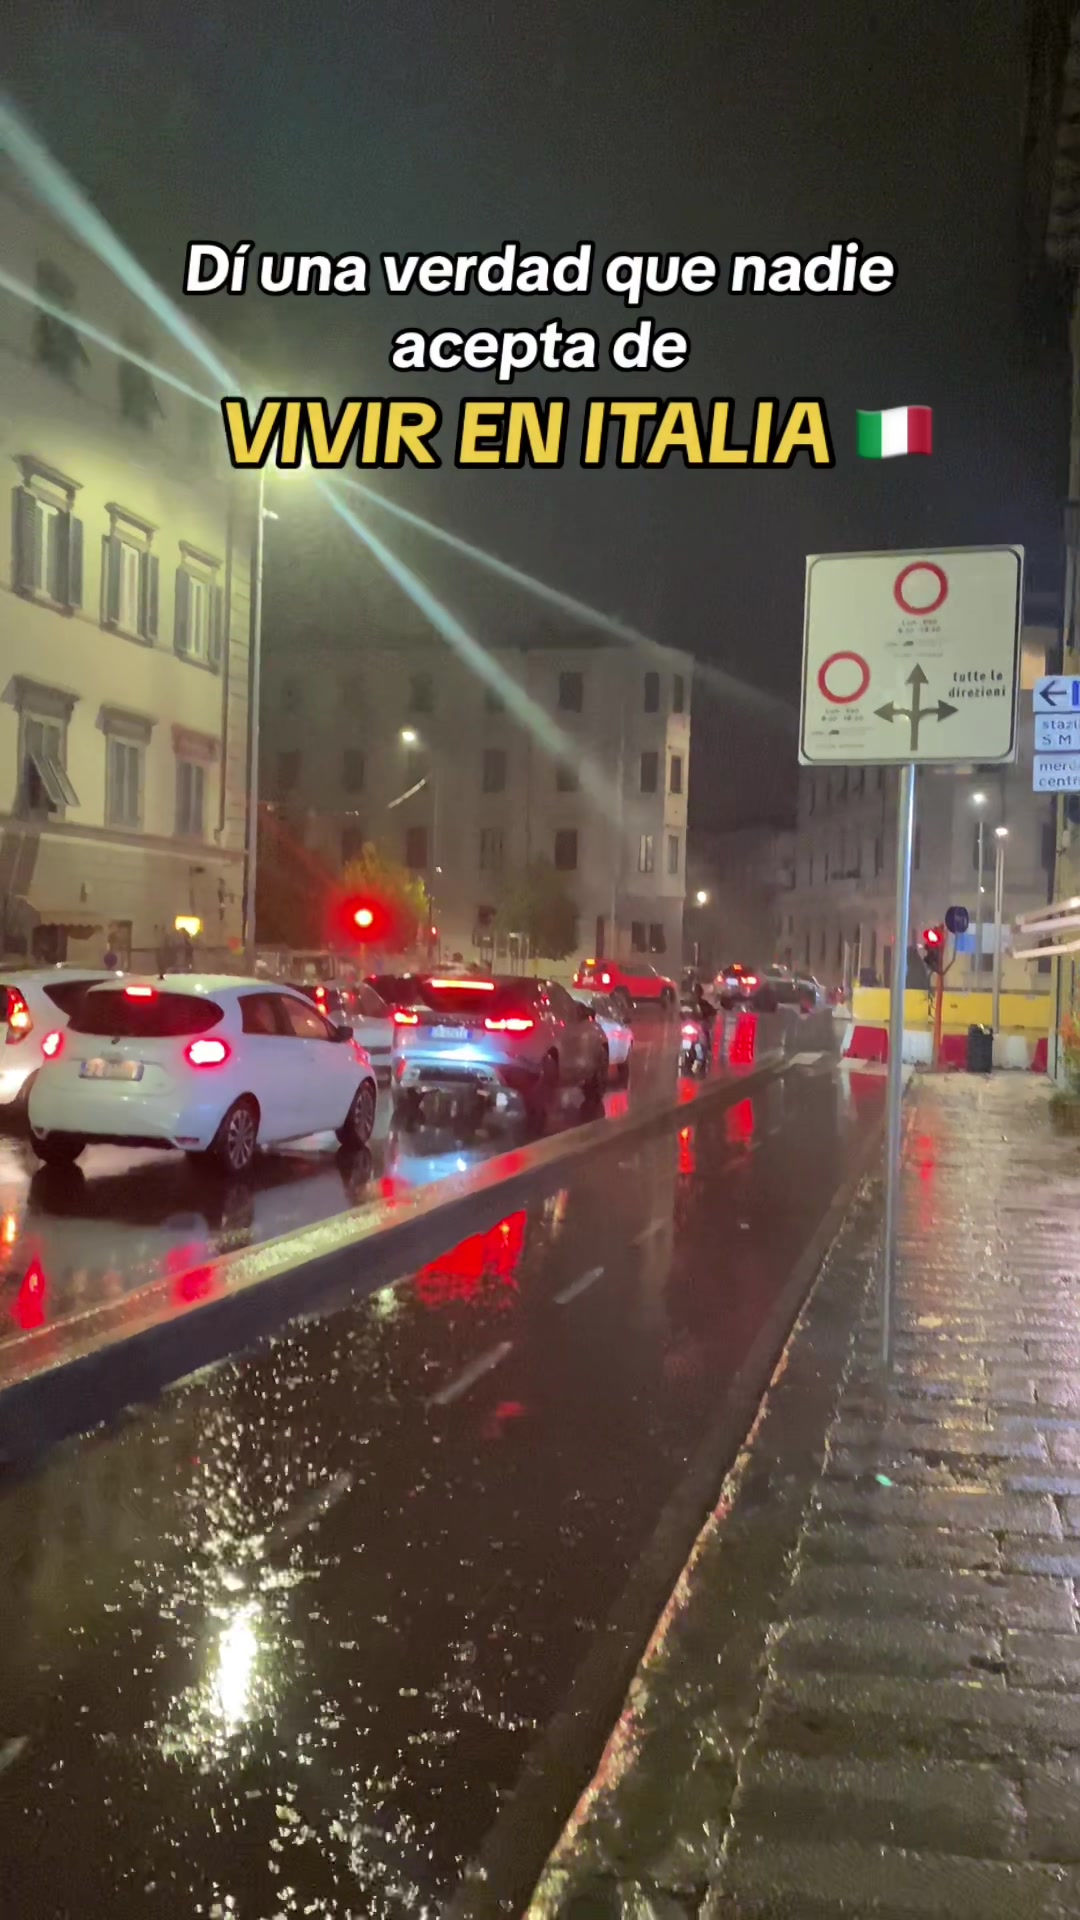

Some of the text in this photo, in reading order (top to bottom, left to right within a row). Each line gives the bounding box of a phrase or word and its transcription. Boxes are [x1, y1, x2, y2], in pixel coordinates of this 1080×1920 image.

[953, 671, 986, 682] tutte
[948, 684, 1006, 698] direzioni
[1042, 719, 1080, 730] stazi
[1058, 734, 1072, 745] M
[1038, 776, 1080, 787] centr
